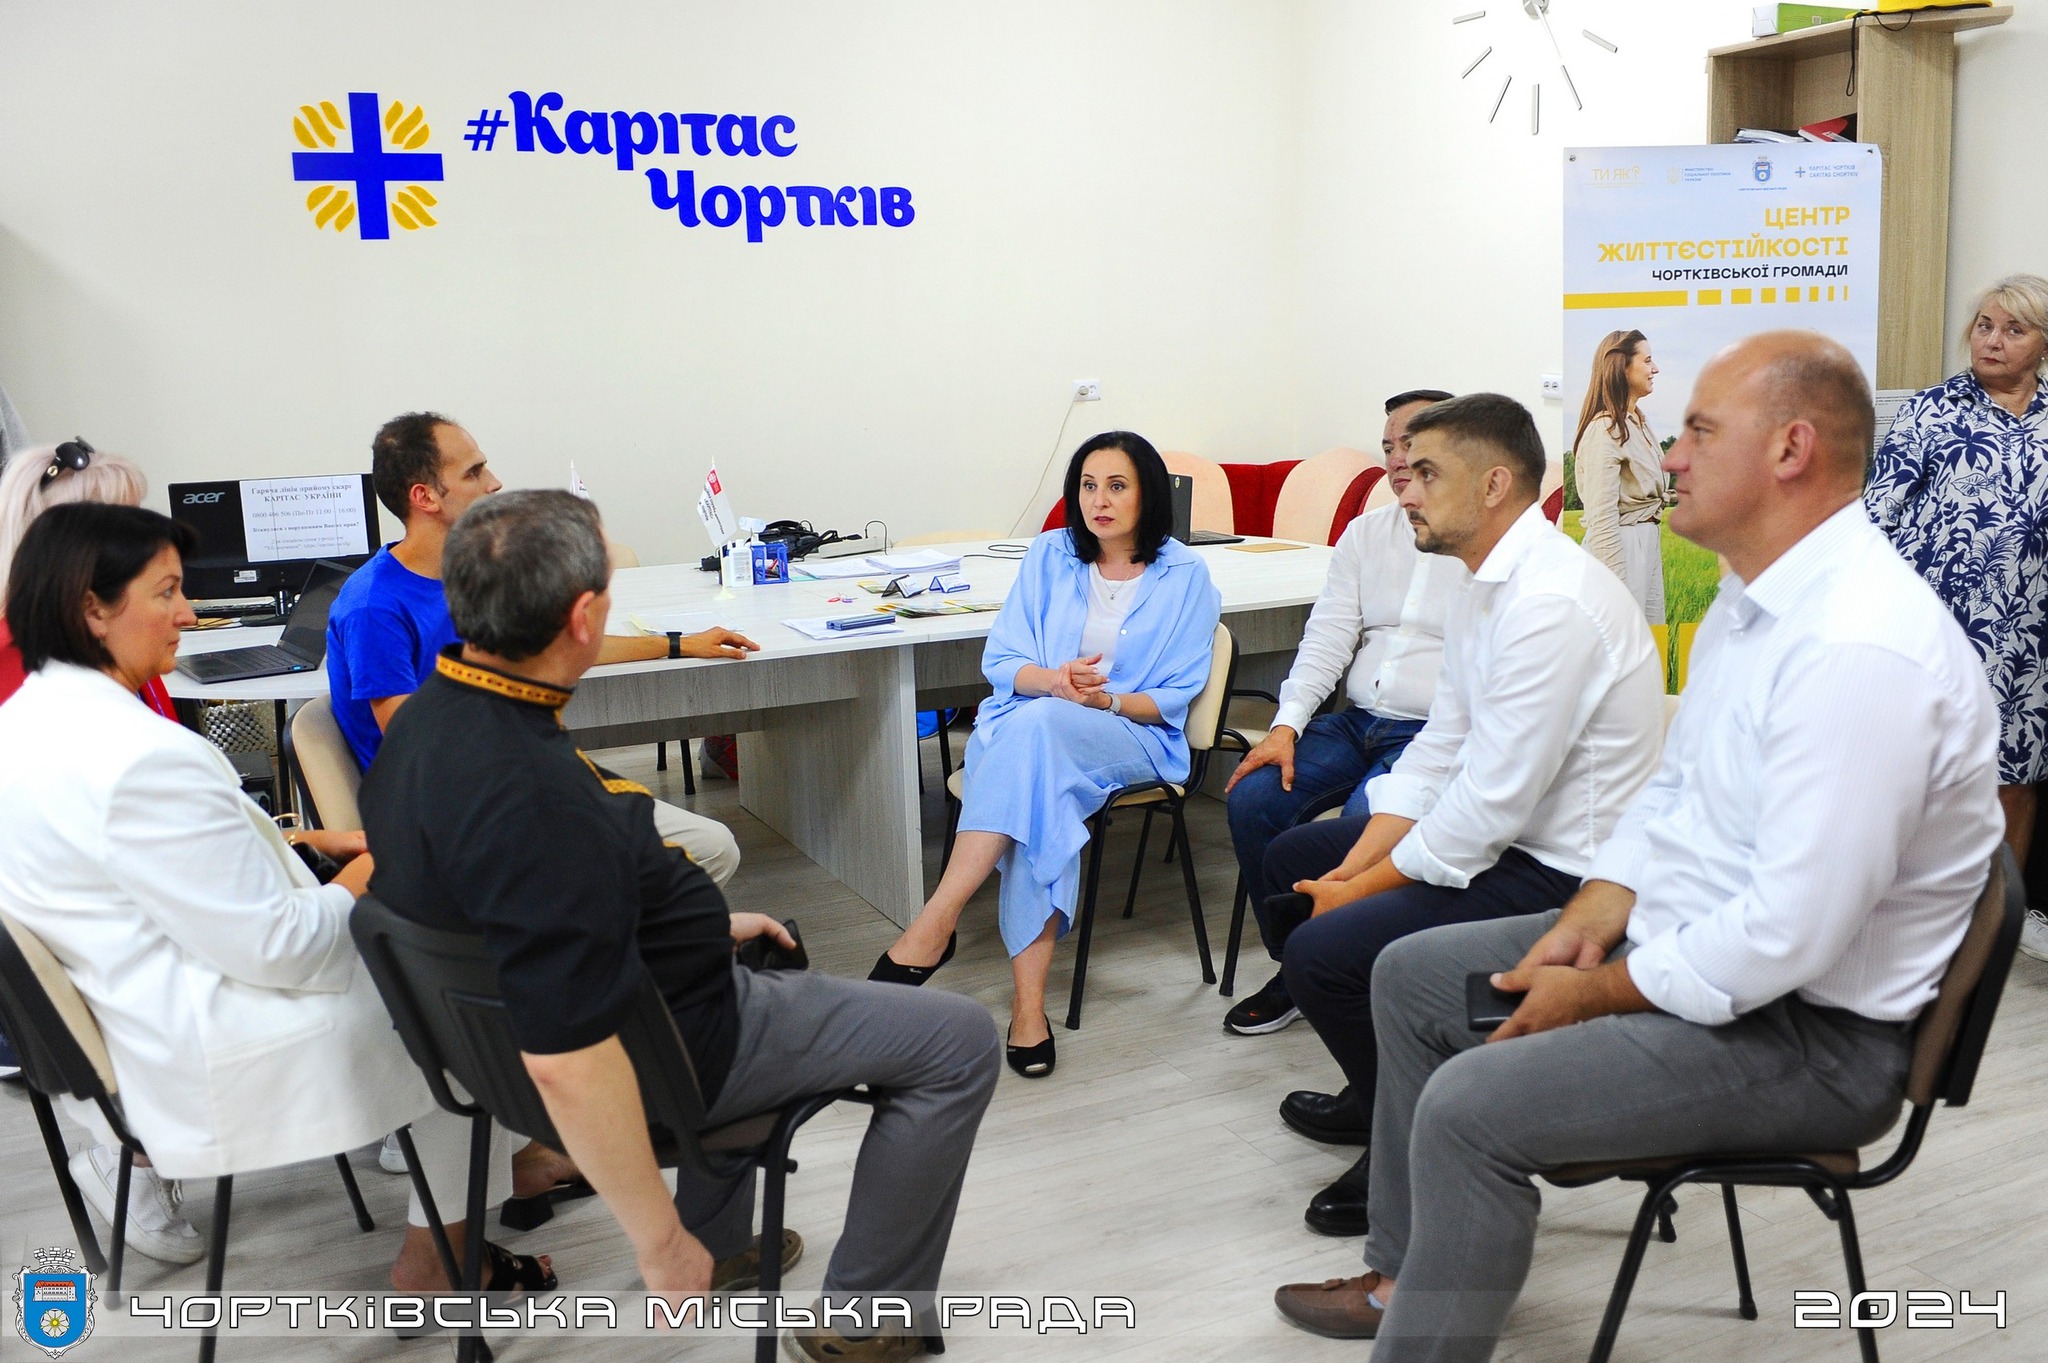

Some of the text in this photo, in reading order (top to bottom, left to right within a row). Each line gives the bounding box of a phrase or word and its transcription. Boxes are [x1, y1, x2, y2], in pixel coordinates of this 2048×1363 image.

[463, 90, 799, 170] #Карітас
[1592, 168, 1610, 180] ТИ
[645, 167, 916, 242] Чортків
[1765, 206, 1850, 230] ЦЕНТР
[1598, 233, 1849, 262] ЖИТТЄСТІЙКОСТІ
[1652, 264, 1848, 281] ЧОРТКІВСЬКОЇ ГРОМАДИ
[182, 491, 226, 505] acer
[252, 486, 278, 495] Гаряча
[300, 484, 330, 493] прийому
[304, 490, 342, 500] УКРАЇНИ
